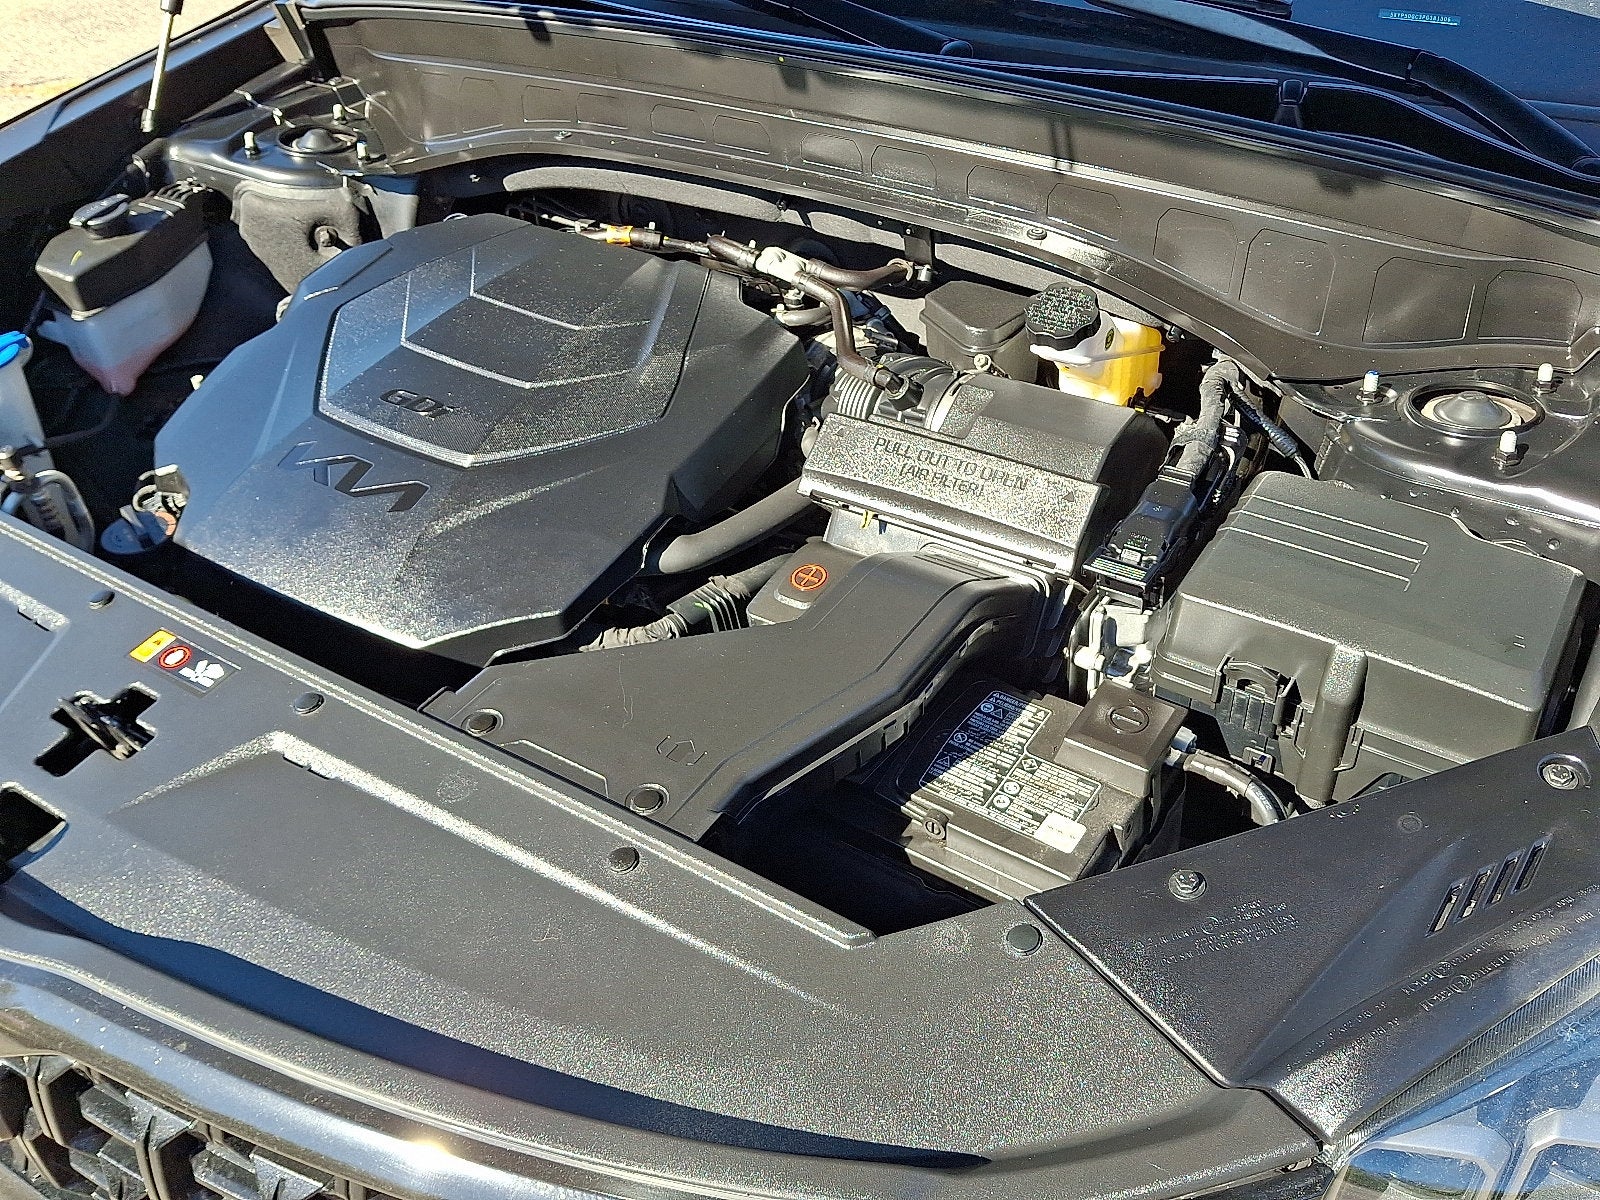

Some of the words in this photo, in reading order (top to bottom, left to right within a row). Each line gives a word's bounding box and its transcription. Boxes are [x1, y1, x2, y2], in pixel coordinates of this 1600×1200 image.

[873, 437, 912, 460] PULL
[917, 449, 953, 470] OUT
[956, 458, 979, 477] TO
[980, 465, 1030, 491] OPEN
